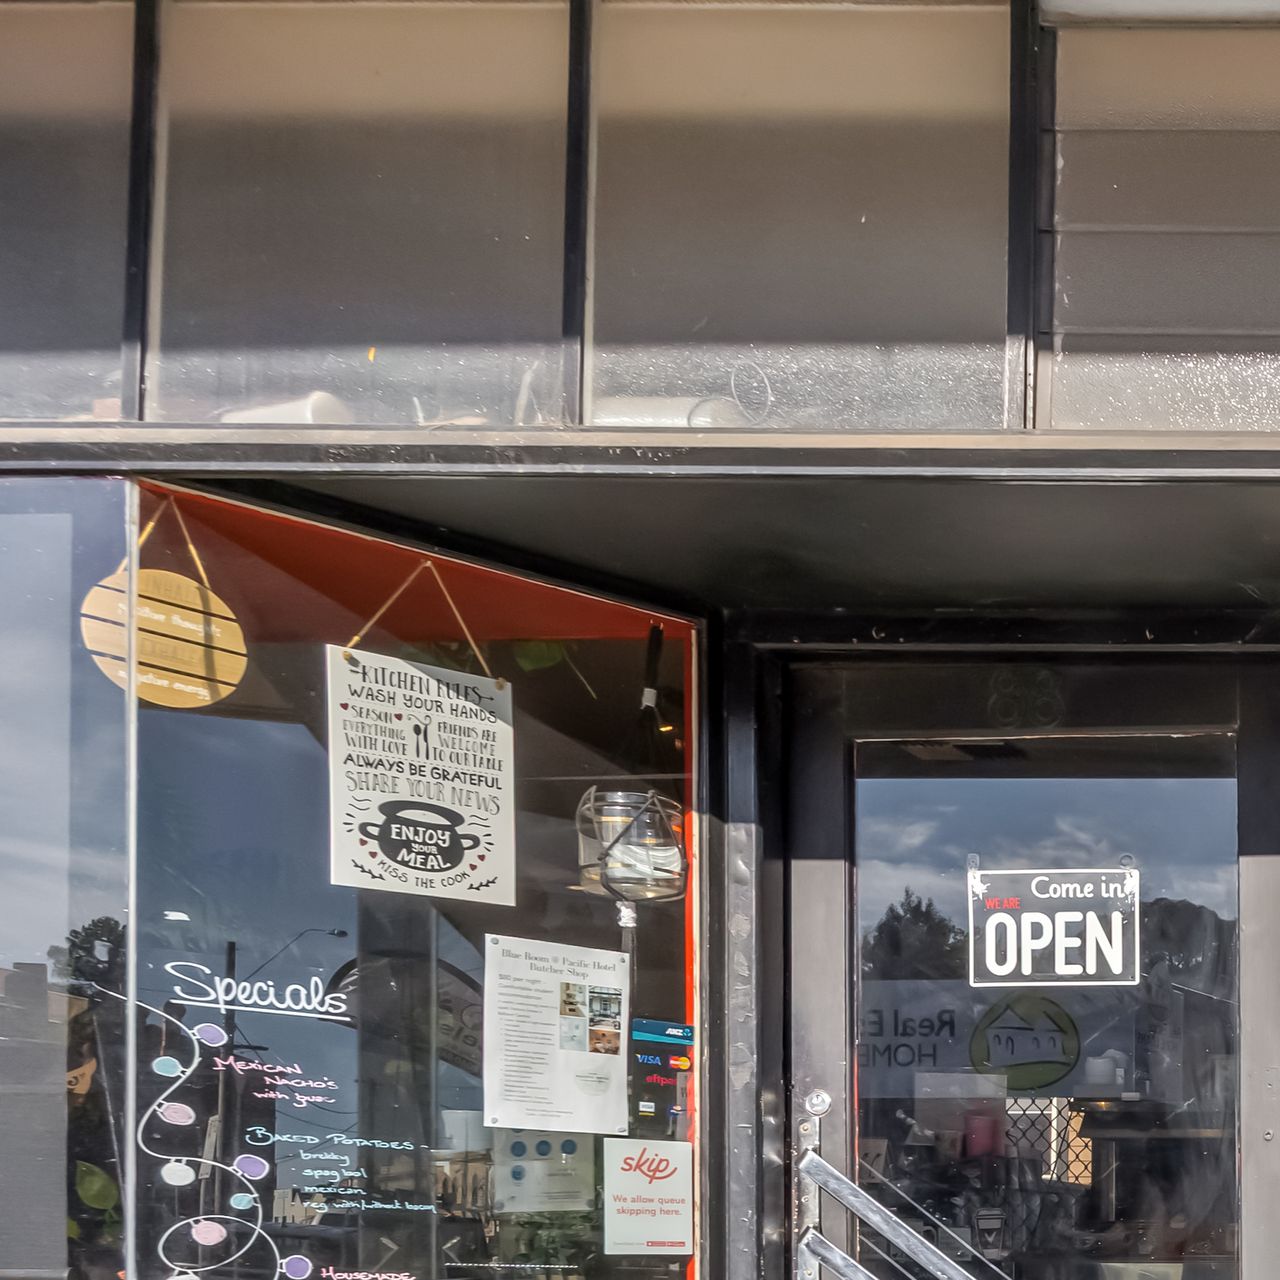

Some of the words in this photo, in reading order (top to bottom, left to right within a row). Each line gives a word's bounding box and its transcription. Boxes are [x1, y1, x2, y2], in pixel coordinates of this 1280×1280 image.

[361, 664, 430, 696] KITCHEN
[348, 684, 396, 706] WASH
[403, 694, 445, 714] YOUR
[450, 703, 497, 724] HANDS
[351, 705, 393, 724] SEASON
[343, 720, 406, 741] EVERYTHING
[437, 721, 479, 740] FRIENDS
[481, 729, 497, 743] ARE
[344, 733, 378, 750] WITH
[382, 739, 408, 756] LOVE
[437, 734, 496, 757] WELCOME
[432, 747, 446, 762] TO
[449, 751, 470, 767] OUR
[472, 754, 504, 771] TABLE
[343, 754, 405, 774] ALWAYS
[409, 762, 427, 777] BE
[430, 766, 502, 790] GRATEFUL
[344, 770, 400, 794] SHARE
[406, 778, 446, 802] YOUR
[451, 787, 500, 816] NEWS
[390, 824, 451, 847] ENJOY
[397, 848, 452, 870] MEAL
[411, 843, 438, 855] YOUR
[377, 859, 408, 883] KISS
[415, 877, 436, 889] THE
[441, 871, 471, 888] COOK
[1030, 876, 1094, 900] Come
[985, 898, 1001, 910] WE
[1003, 898, 1021, 909] ARE
[985, 910, 1123, 976] OPEN
[164, 961, 348, 1014] Specials
[635, 1053, 662, 1067] VISA
[620, 1147, 678, 1184] skip
[612, 1194, 628, 1203] We
[630, 1194, 656, 1204] allow
[658, 1196, 686, 1206] queue
[616, 1206, 658, 1218] skipping
